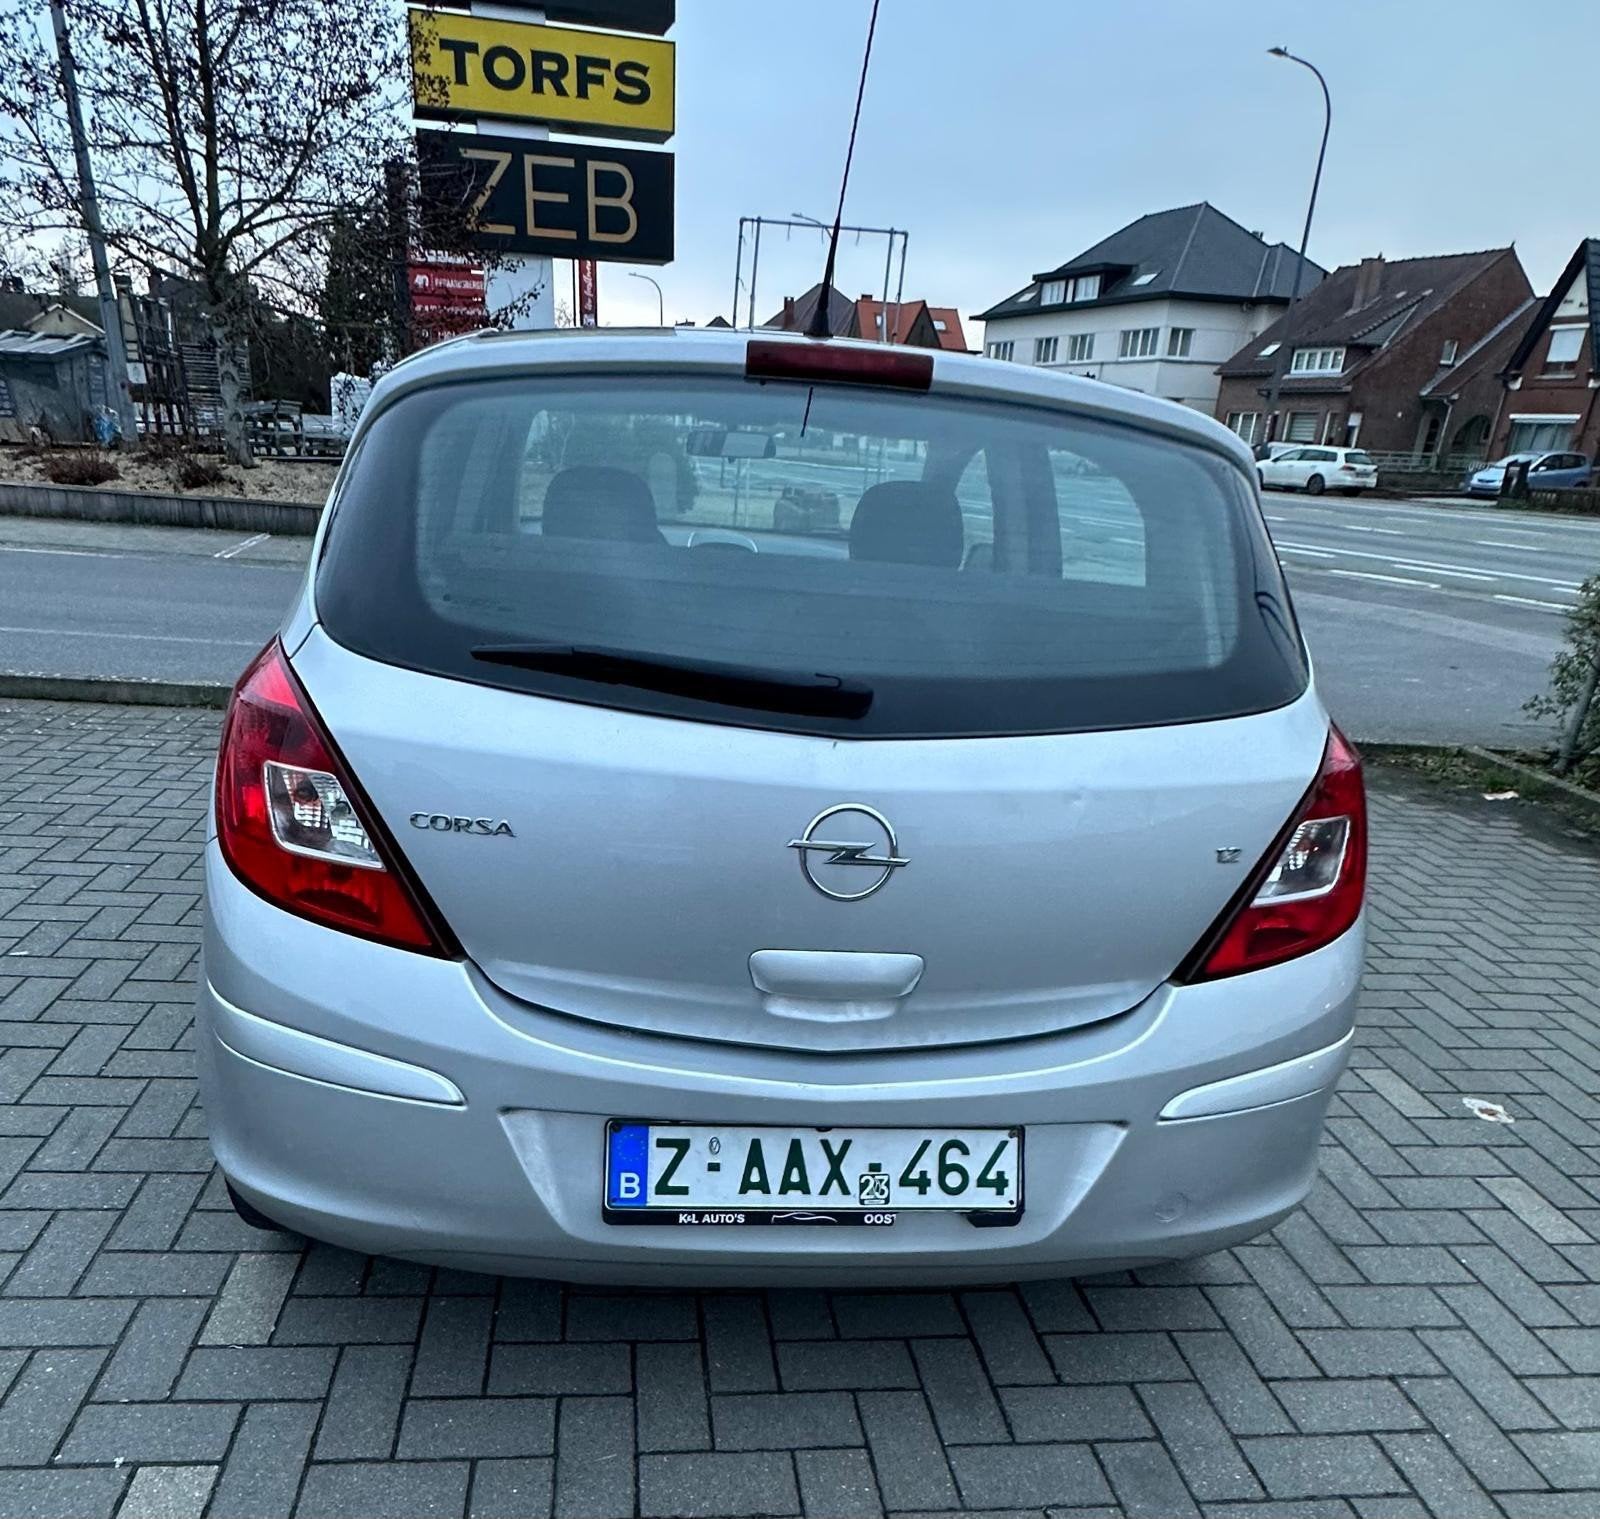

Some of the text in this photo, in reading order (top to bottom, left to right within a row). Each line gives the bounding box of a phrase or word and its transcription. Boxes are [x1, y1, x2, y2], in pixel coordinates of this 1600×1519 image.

[438, 38, 652, 105] TORFS
[459, 148, 638, 243] ZEB
[409, 811, 516, 838] CORSA
[620, 1172, 640, 1199] B
[860, 1175, 889, 1200] 23
[701, 1213, 745, 1224] AUTO'S
